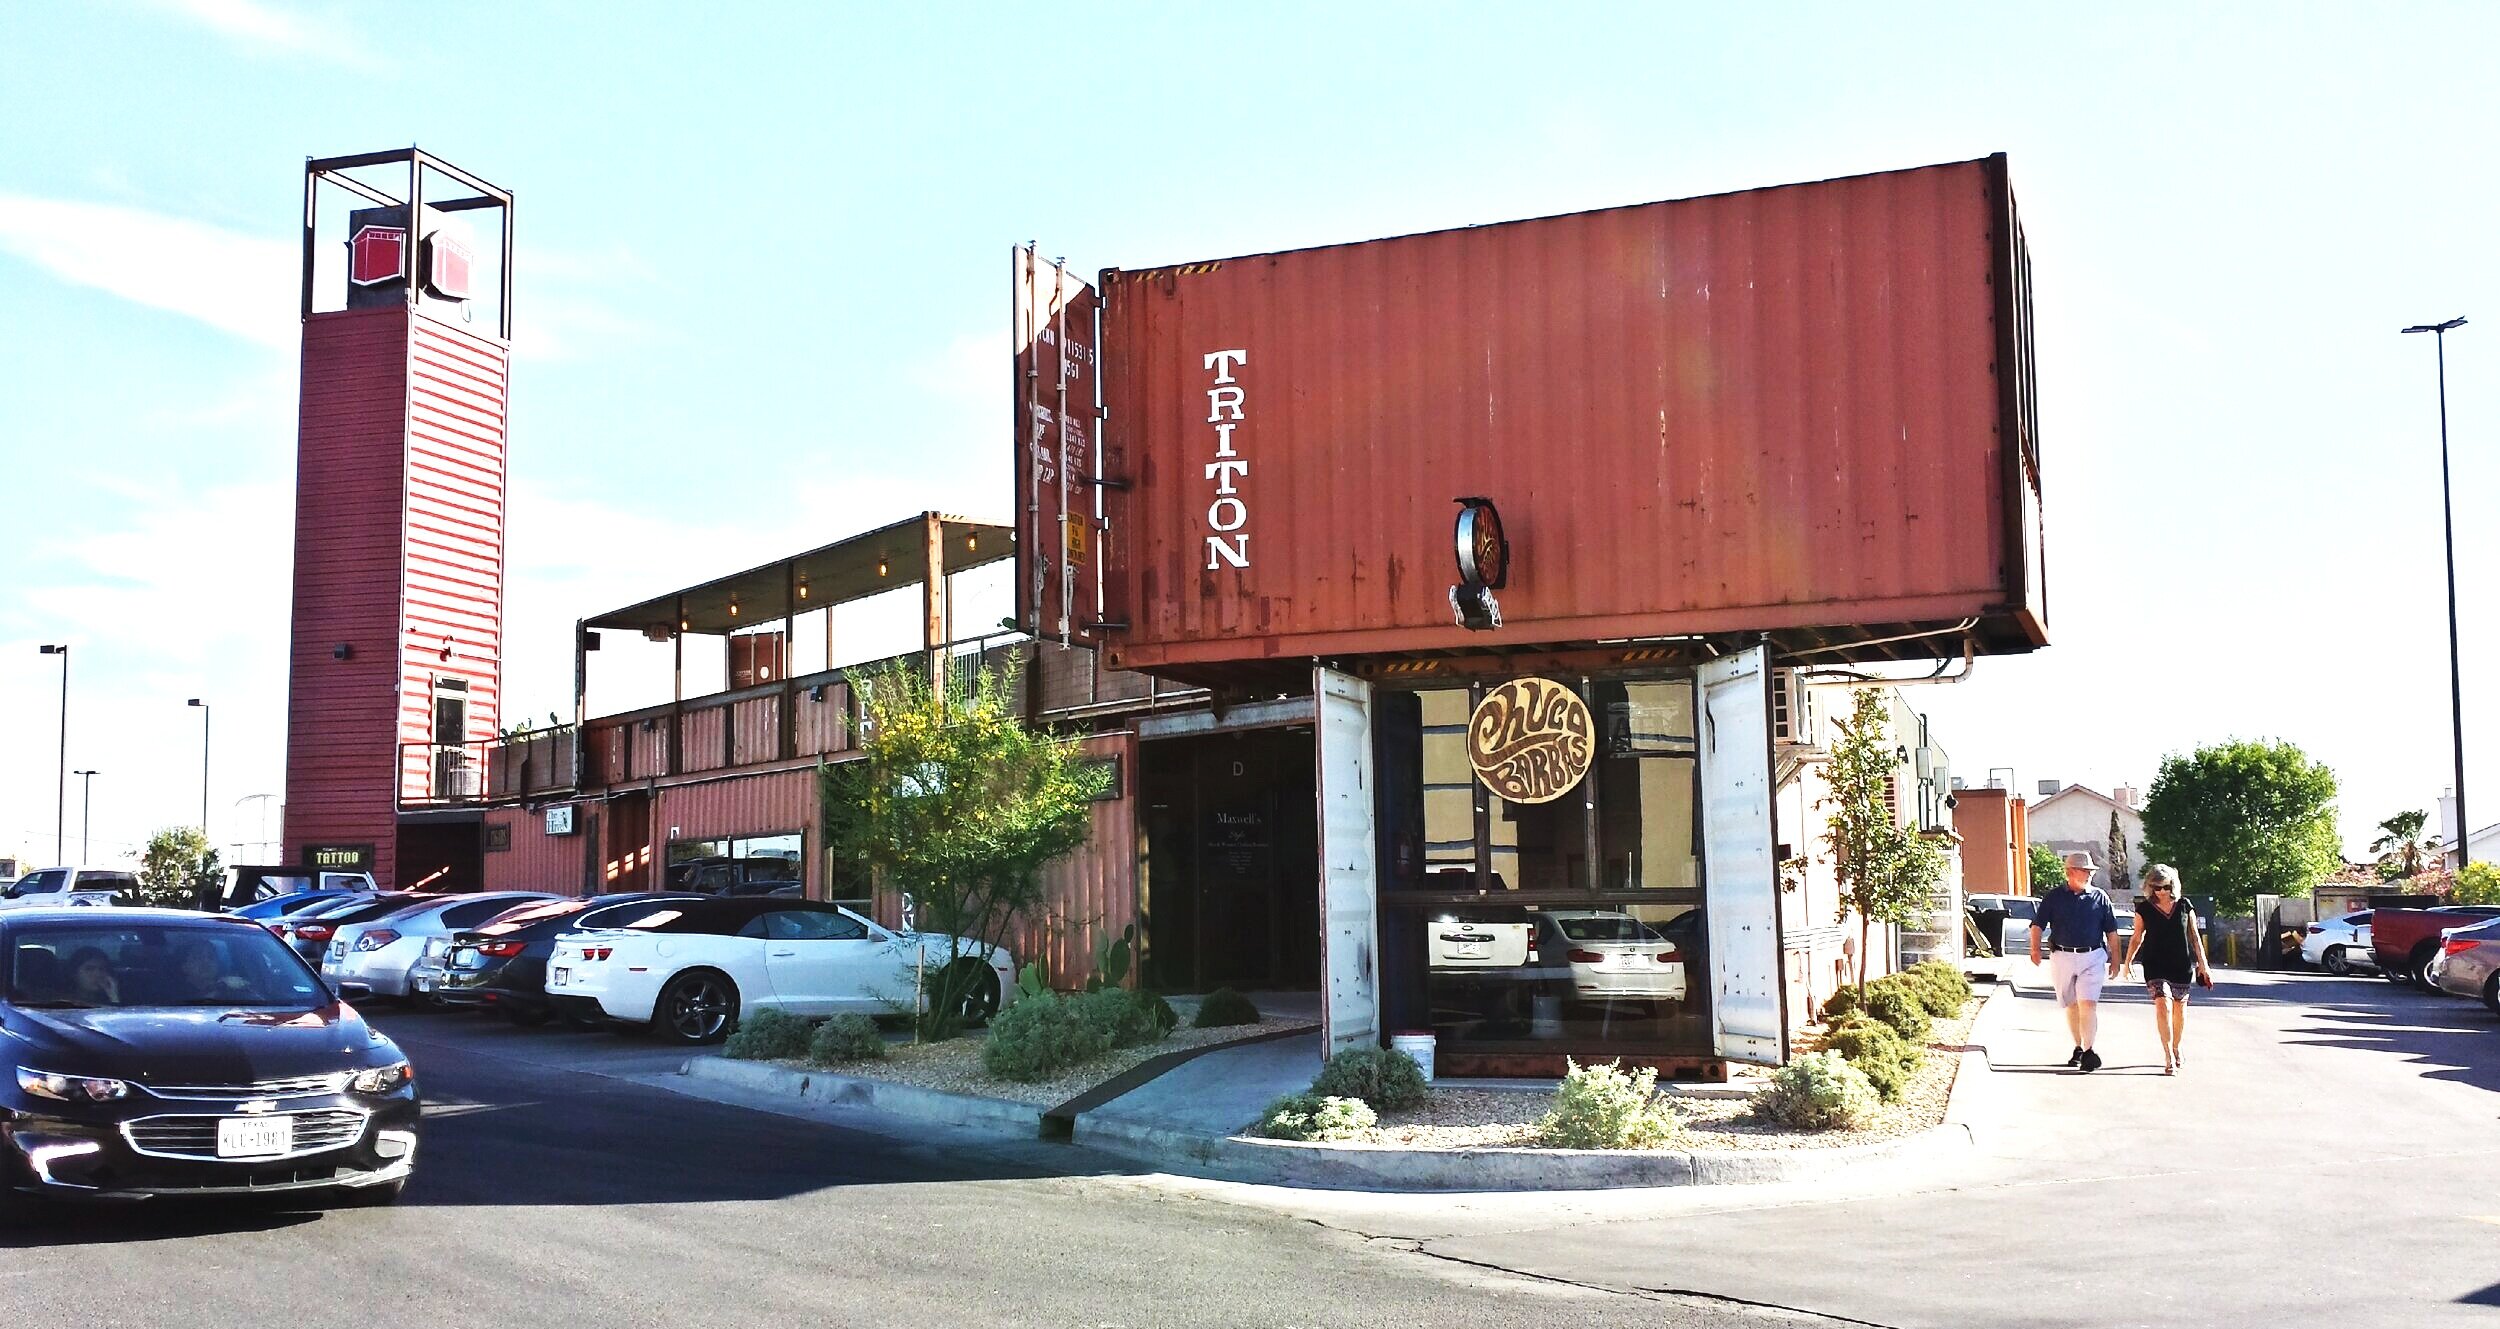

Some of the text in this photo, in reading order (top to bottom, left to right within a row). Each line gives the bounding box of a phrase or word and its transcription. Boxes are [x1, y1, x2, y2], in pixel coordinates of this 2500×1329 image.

[1204, 349, 1249, 570] TRITON
[1233, 762, 1244, 776] D
[1478, 736, 1586, 798] BARBAS
[1216, 812, 1262, 824] Maxwell's
[316, 851, 359, 864] TATTOO
